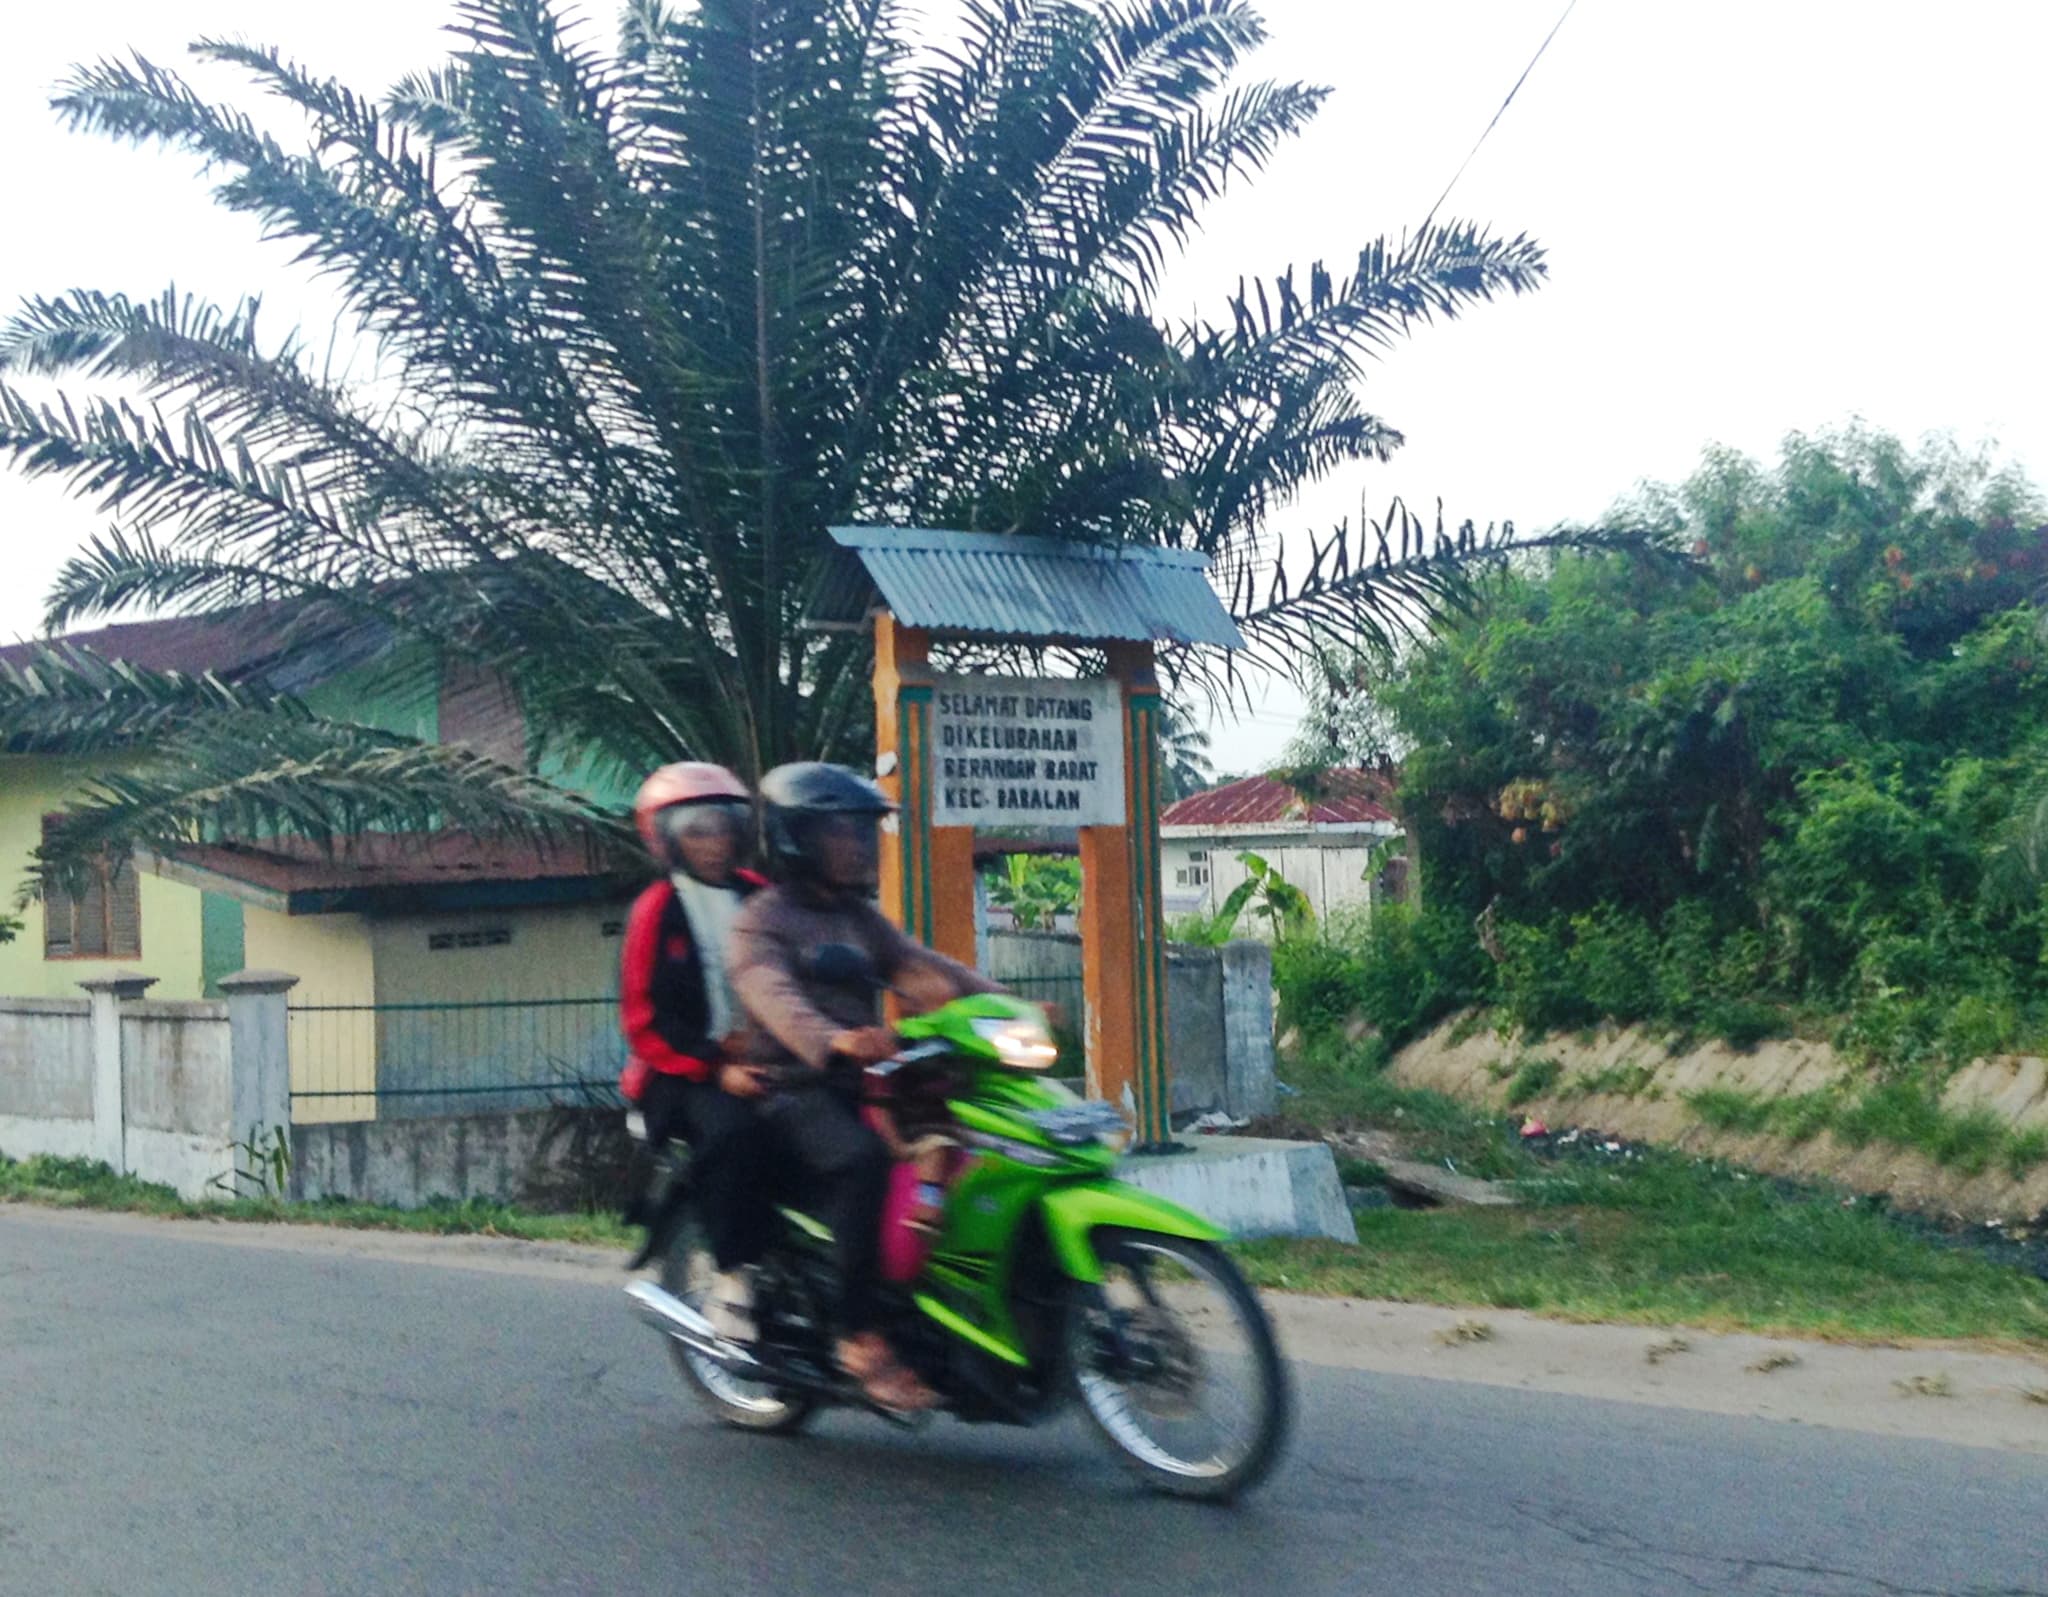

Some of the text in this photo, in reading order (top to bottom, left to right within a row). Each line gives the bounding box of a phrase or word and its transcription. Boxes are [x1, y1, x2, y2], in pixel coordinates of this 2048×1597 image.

[940, 693, 1092, 721] SELAMAT DATANG
[943, 725, 1078, 751] DIKELURAHAN
[1046, 759, 1098, 781] BARAT
[998, 789, 1080, 810] BABALAN
